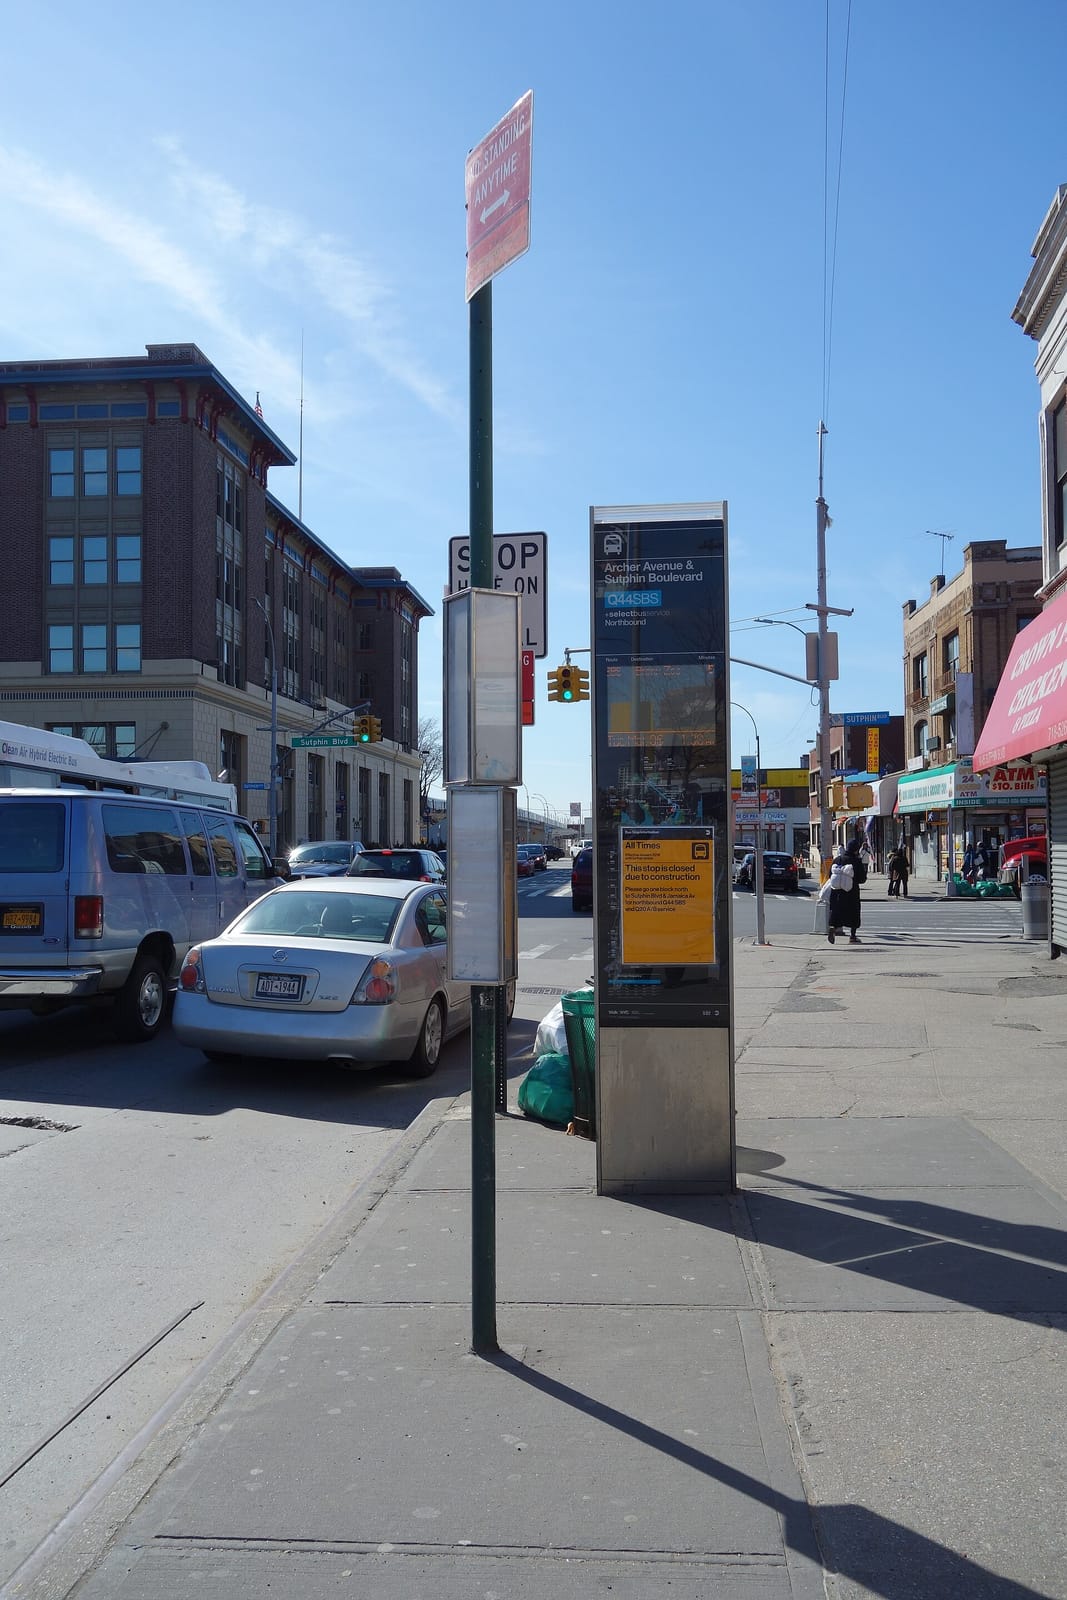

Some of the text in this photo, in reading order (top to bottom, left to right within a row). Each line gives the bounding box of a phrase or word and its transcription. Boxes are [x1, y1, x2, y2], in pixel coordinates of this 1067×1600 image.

[469, 114, 525, 177] NO STANDING
[474, 151, 517, 207] ANYTIME
[457, 542, 538, 573] SOP
[604, 559, 695, 573] Archer Avenue &
[515, 576, 537, 594] ON
[604, 571, 703, 585] Sutphin Boulevard
[604, 618, 647, 626] Northbound
[1010, 622, 1062, 680] CROWN
[846, 714, 877, 723] SUTPHIN
[300, 739, 329, 747] Sutphin
[2, 742, 78, 767] Clean Air Hybrid Electric Bus
[962, 775, 974, 783] 24
[993, 767, 1035, 782] ATM
[1014, 782, 1034, 790] Bills
[625, 841, 661, 849] All Times
[625, 864, 696, 874] This stop is closed
[625, 873, 701, 881] due to construction
